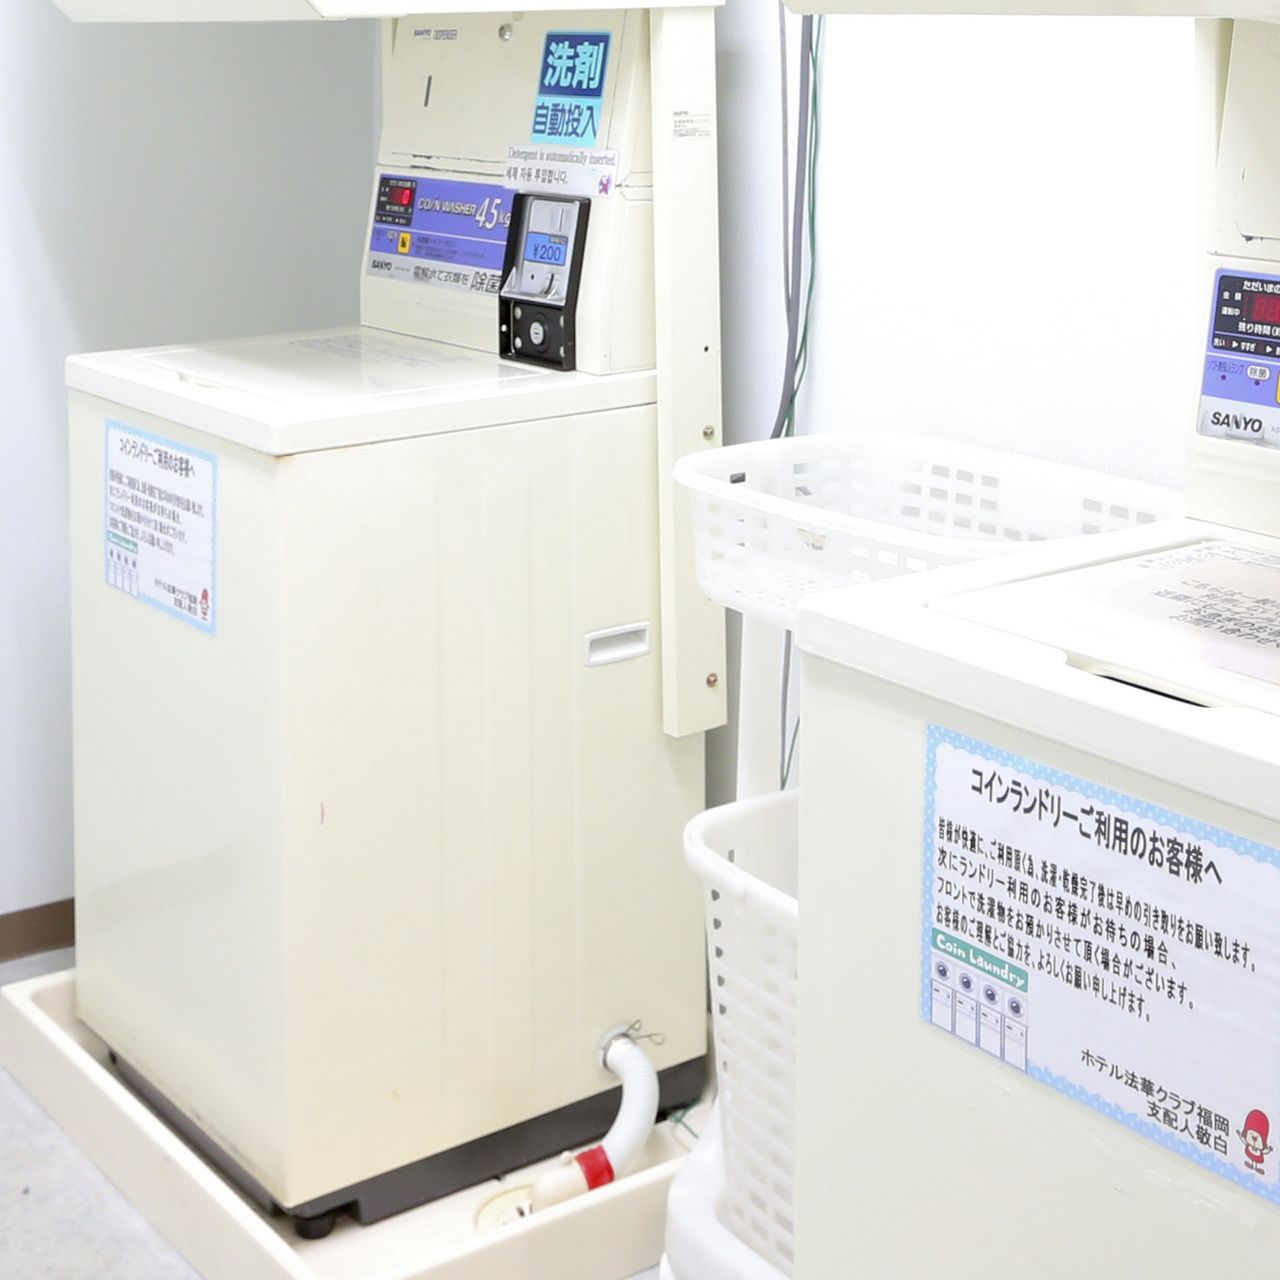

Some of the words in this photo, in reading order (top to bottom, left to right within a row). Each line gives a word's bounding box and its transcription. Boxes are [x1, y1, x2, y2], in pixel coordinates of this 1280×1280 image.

[543, 40, 605, 90] 洗剤
[532, 102, 598, 140] 自動投入
[442, 201, 476, 215] WASHER
[371, 259, 393, 271] SANYO
[532, 242, 562, 263] ¥200
[470, 271, 502, 294] 除菌
[1211, 411, 1263, 433] SANYO
[971, 768, 1223, 885] コインランドリーご利用のお客様へ
[937, 846, 1177, 970] 次にランドリー利用のお客様がお待ちの場合、
[936, 933, 967, 959] Coin
[969, 950, 1025, 987] Laundry
[936, 901, 1152, 1023] お客様のご理解とご協力を、よろしくお願い申し上げます。
[937, 876, 1194, 1010] フロントで洗濯物をお預かりさせて頂く場合がございます。
[1081, 1048, 1230, 1138] ホテル法華クラブ福岡
[1146, 1099, 1228, 1156] 支配人敬白
